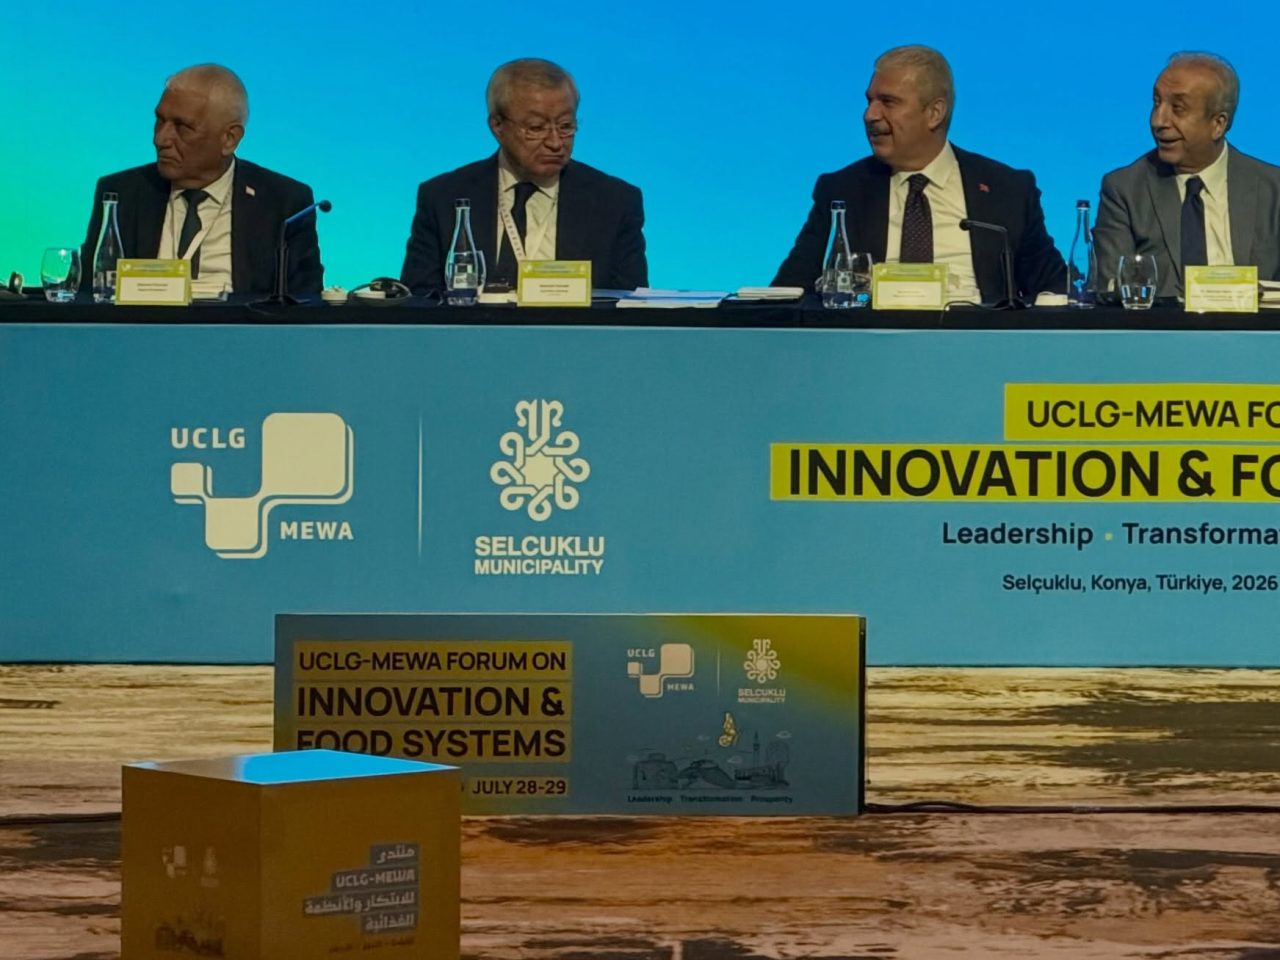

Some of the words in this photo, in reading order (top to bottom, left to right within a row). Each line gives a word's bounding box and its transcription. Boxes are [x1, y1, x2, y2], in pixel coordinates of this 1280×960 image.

[1027, 400, 1240, 428] UCLG-MEWA
[171, 427, 246, 449] UCLG
[789, 449, 1160, 497] INNOVATION
[1178, 451, 1216, 497] &
[280, 521, 354, 540] MEWA
[942, 522, 1094, 551] Leadership
[474, 536, 605, 557] SELCUKLU
[474, 559, 604, 575] MUNICIPALITY
[1002, 574, 1087, 594] Selçuklu,
[1091, 576, 1152, 595] Konya,
[1156, 575, 1228, 595] Türkiye,
[1231, 575, 1279, 591] 2026
[300, 652, 442, 671] UCLG-MEWA
[447, 652, 528, 671] FORUM
[532, 652, 566, 671] ON
[627, 649, 655, 658] UCLG
[298, 687, 530, 716] INNOVATION
[540, 687, 565, 716] &
[402, 729, 567, 757] SYSTEMS
[472, 780, 513, 795] JULY
[516, 780, 566, 795] 28-29
[335, 869, 416, 888] UCLG-MEWA
